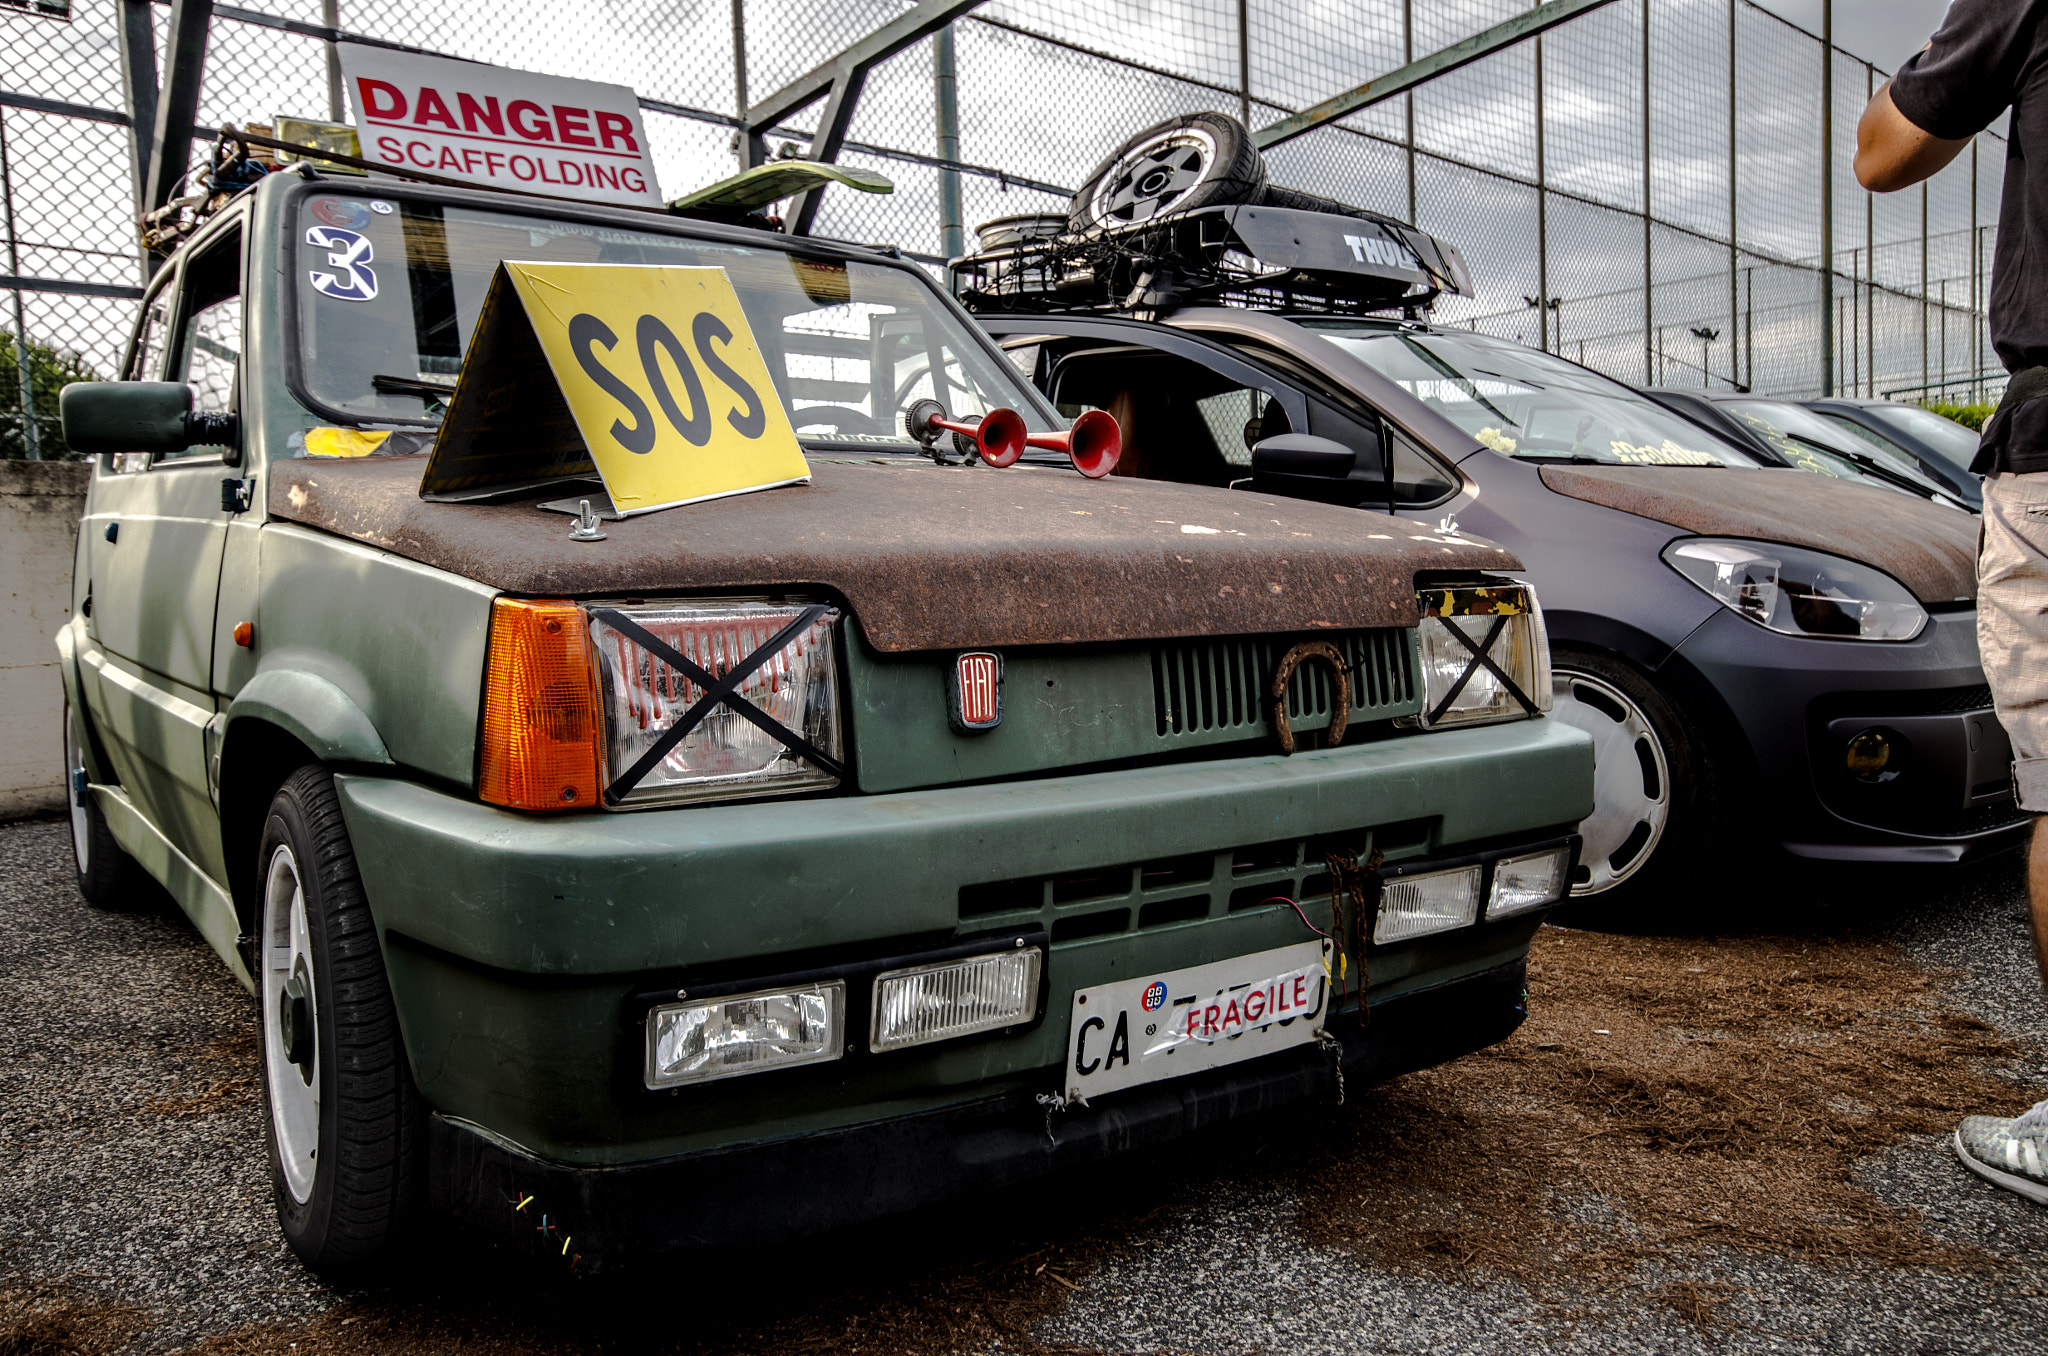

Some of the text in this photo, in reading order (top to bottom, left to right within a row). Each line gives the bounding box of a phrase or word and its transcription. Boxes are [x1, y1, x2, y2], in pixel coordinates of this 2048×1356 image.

[356, 77, 639, 152] DANGER
[376, 135, 648, 193] SCAFFOLDING
[306, 226, 378, 301] 3
[568, 312, 766, 455] SOS
[961, 657, 994, 719] FIAT
[1186, 974, 1308, 1040] FRAGILE
[1075, 1009, 1131, 1077] CA
